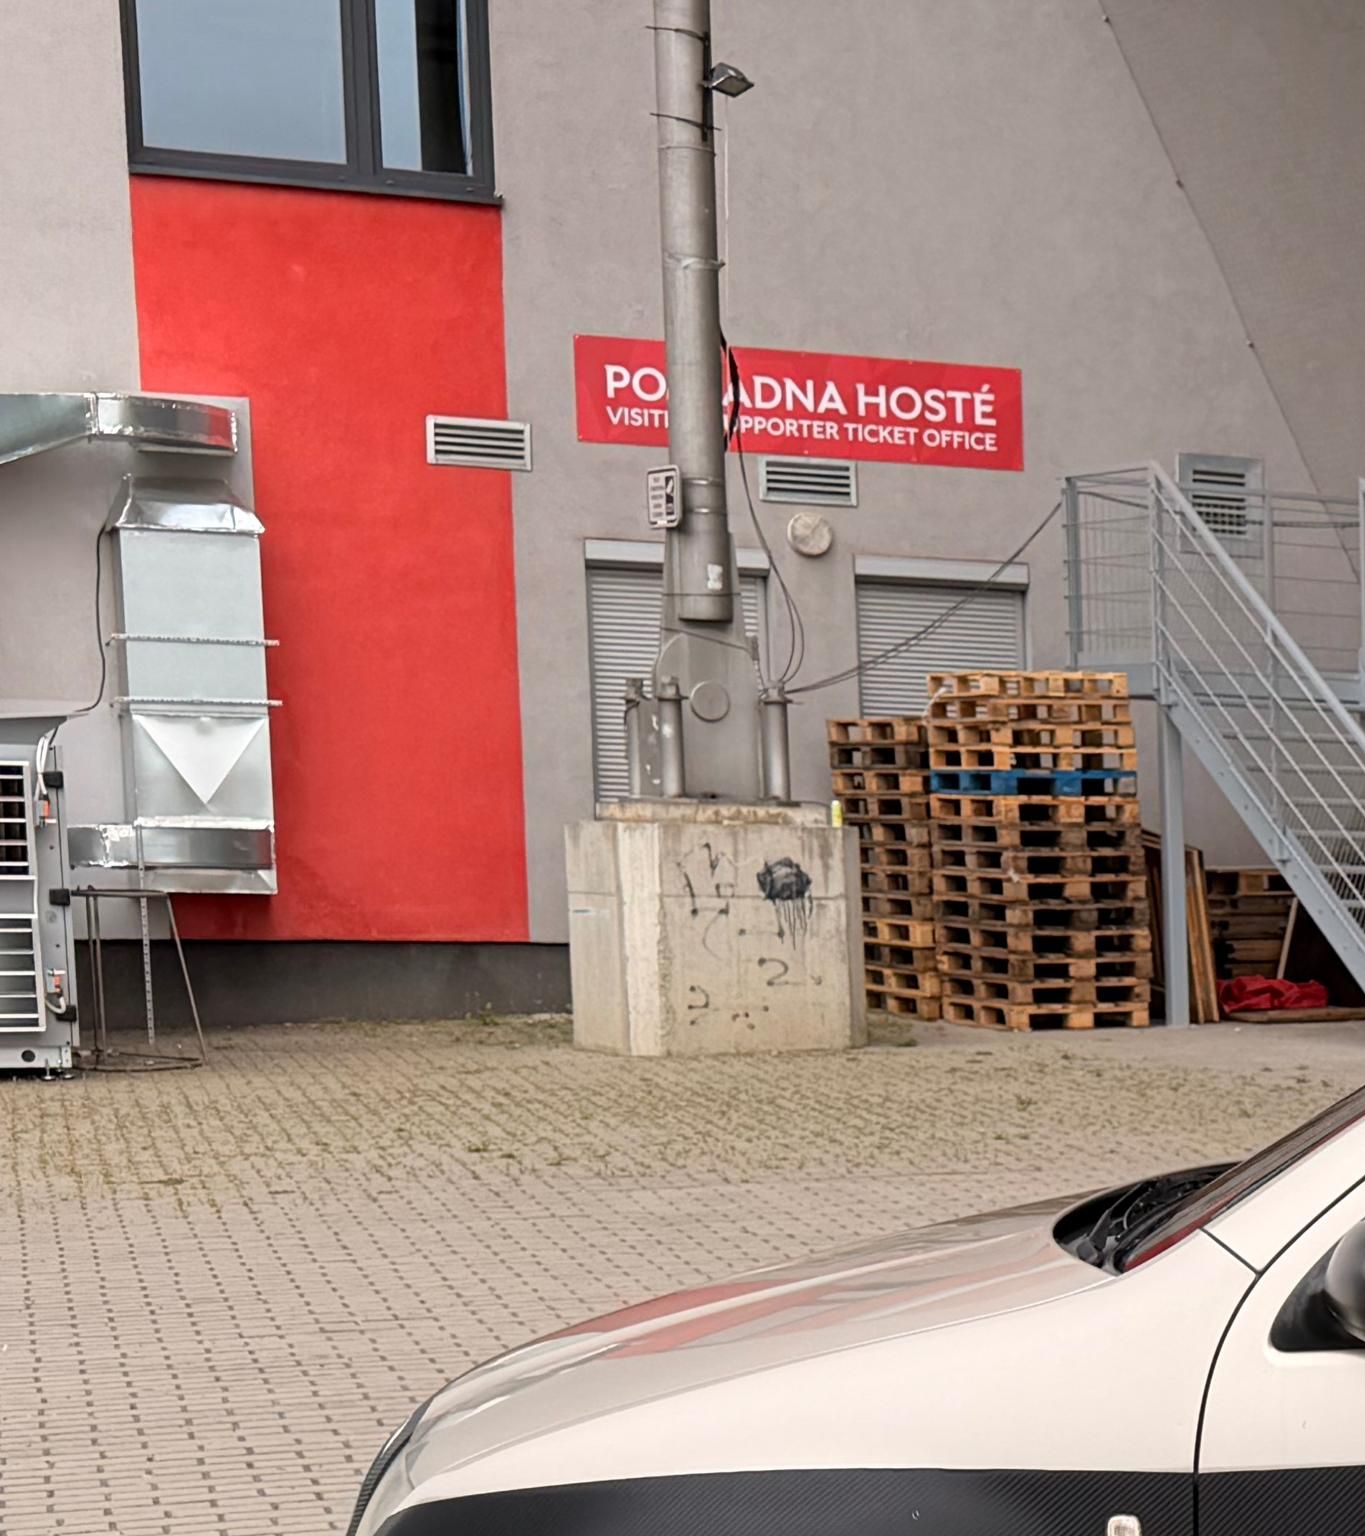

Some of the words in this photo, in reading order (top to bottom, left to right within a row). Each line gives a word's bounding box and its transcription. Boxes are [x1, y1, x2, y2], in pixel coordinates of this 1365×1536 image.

[604, 364, 848, 416] POADNA
[856, 383, 998, 427] HOSTÉ
[843, 422, 919, 447] TICKET
[922, 428, 998, 452] OFFICE
